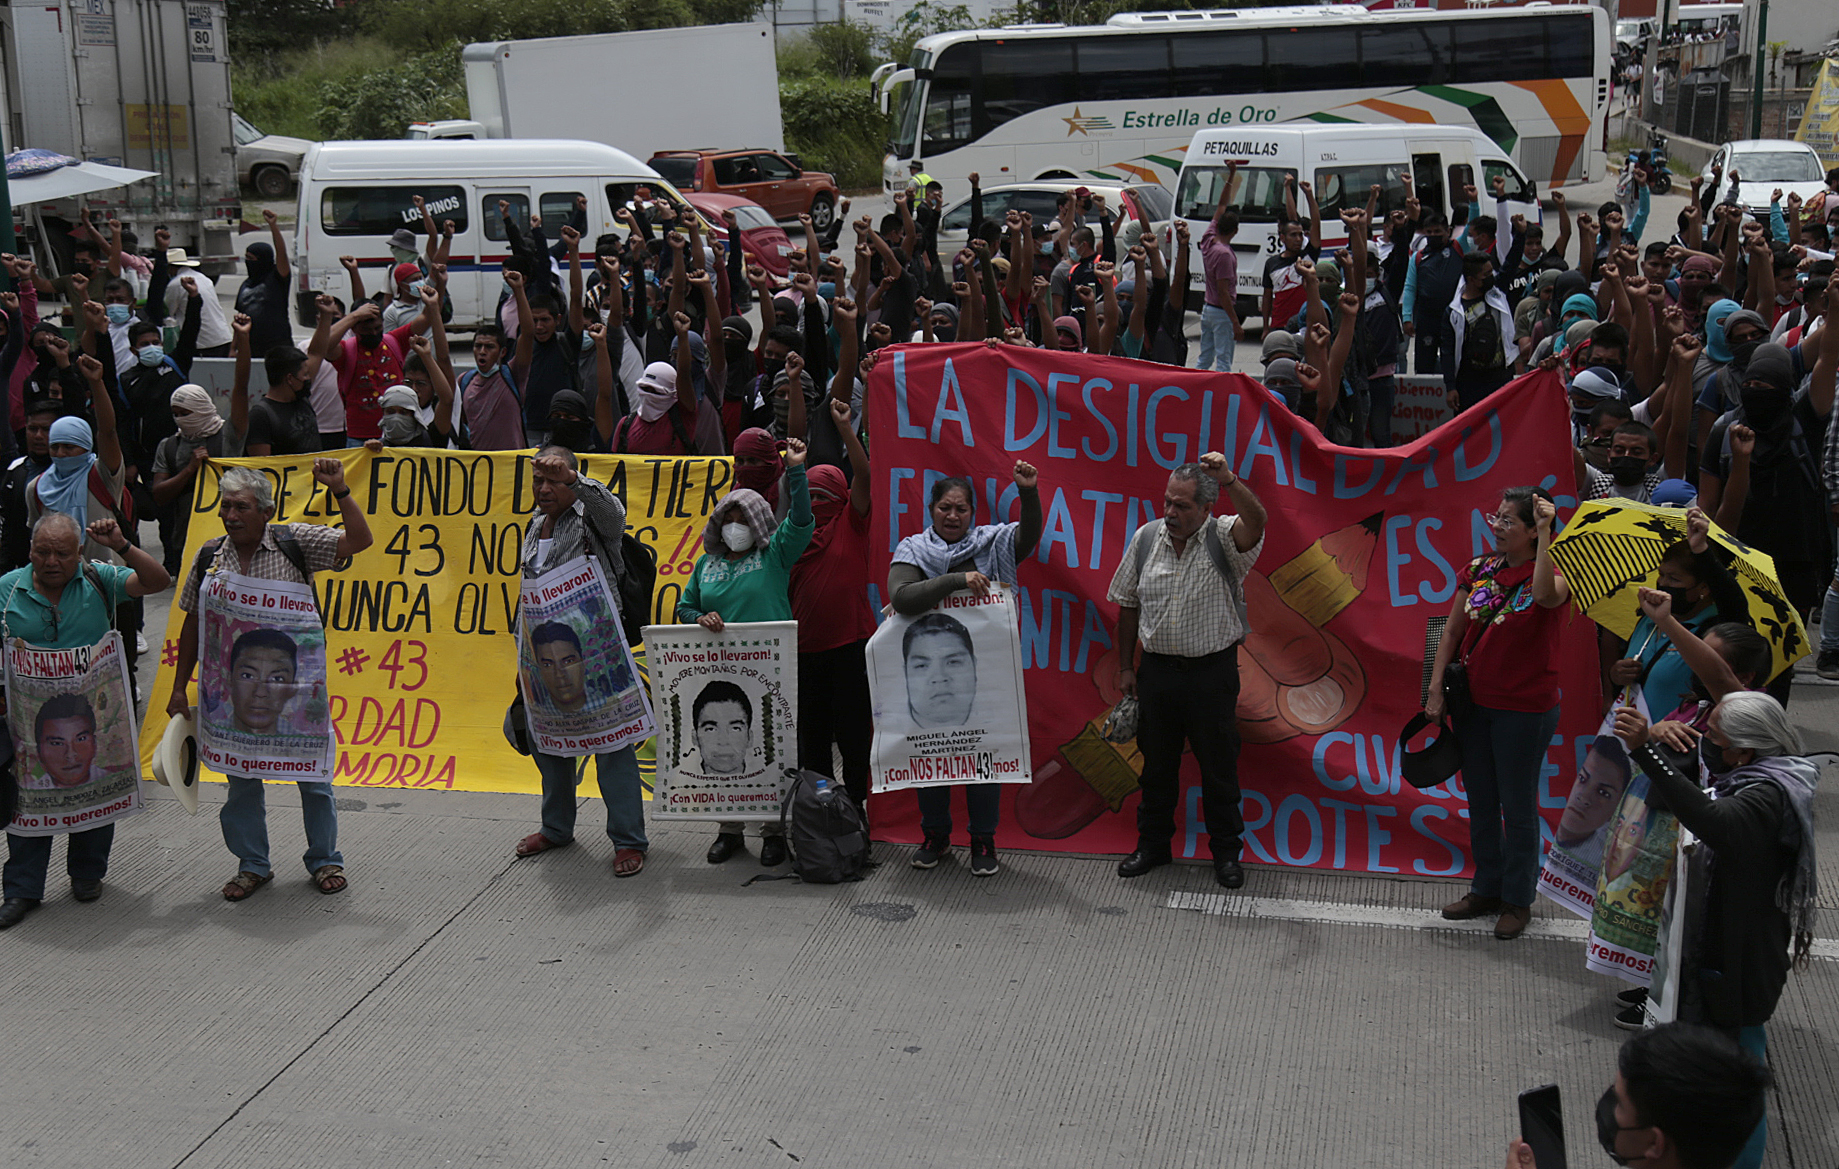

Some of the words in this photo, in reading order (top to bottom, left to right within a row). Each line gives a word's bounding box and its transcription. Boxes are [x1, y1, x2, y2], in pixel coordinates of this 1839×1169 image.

[192, 46, 213, 54] km/hr
[194, 31, 209, 44] 80
[1122, 109, 1200, 129] Estrella
[1206, 107, 1232, 125] de
[1239, 105, 1276, 123] Oro
[1203, 141, 1278, 156] PETAQUILLAS
[401, 206, 424, 223] LOS
[425, 196, 460, 217] PINOS
[893, 351, 975, 448] LA
[367, 454, 493, 519] FONDO
[384, 523, 445, 577] 43
[1385, 514, 1458, 608] ES
[207, 581, 237, 602] ¡Vivo
[240, 593, 258, 606] se
[261, 593, 276, 608] lo
[530, 591, 541, 605] lo
[541, 566, 596, 602] llevaron!
[33, 651, 75, 677] FALTAN
[74, 646, 91, 676] 43!
[663, 651, 691, 666] ¡Vivo
[692, 652, 706, 663] se
[707, 650, 719, 662] lo
[720, 648, 771, 662] llevaron!
[668, 667, 694, 694] MOVERE
[694, 662, 737, 676] MONTAÑAS
[740, 666, 759, 679] POR
[757, 673, 795, 731] ENCONTRARTE
[573, 716, 598, 726] GASPAR
[613, 707, 623, 715] LA
[625, 700, 641, 711] CRUZ
[232, 735, 271, 746] GUERRERO
[274, 740, 285, 748] DE
[289, 740, 300, 748] LA
[303, 741, 324, 749] CRUZ
[563, 737, 577, 749] lo
[578, 719, 645, 750] queremos!
[906, 732, 949, 742] MIGUEL
[225, 752, 238, 767] lo
[241, 759, 317, 773] queremos!
[921, 745, 977, 756] MARTÍNEZ
[884, 767, 910, 785] ¡Con
[909, 757, 934, 781] NOS
[936, 755, 977, 780] FALTAN
[976, 751, 994, 780] 43!
[63, 789, 98, 802] MENDOZA
[669, 793, 691, 806] ¡Con
[691, 792, 716, 804] VIDA
[716, 791, 726, 803] lo
[727, 791, 778, 805] queremos!
[43, 815, 58, 827] lo
[62, 795, 132, 828] queremos!
